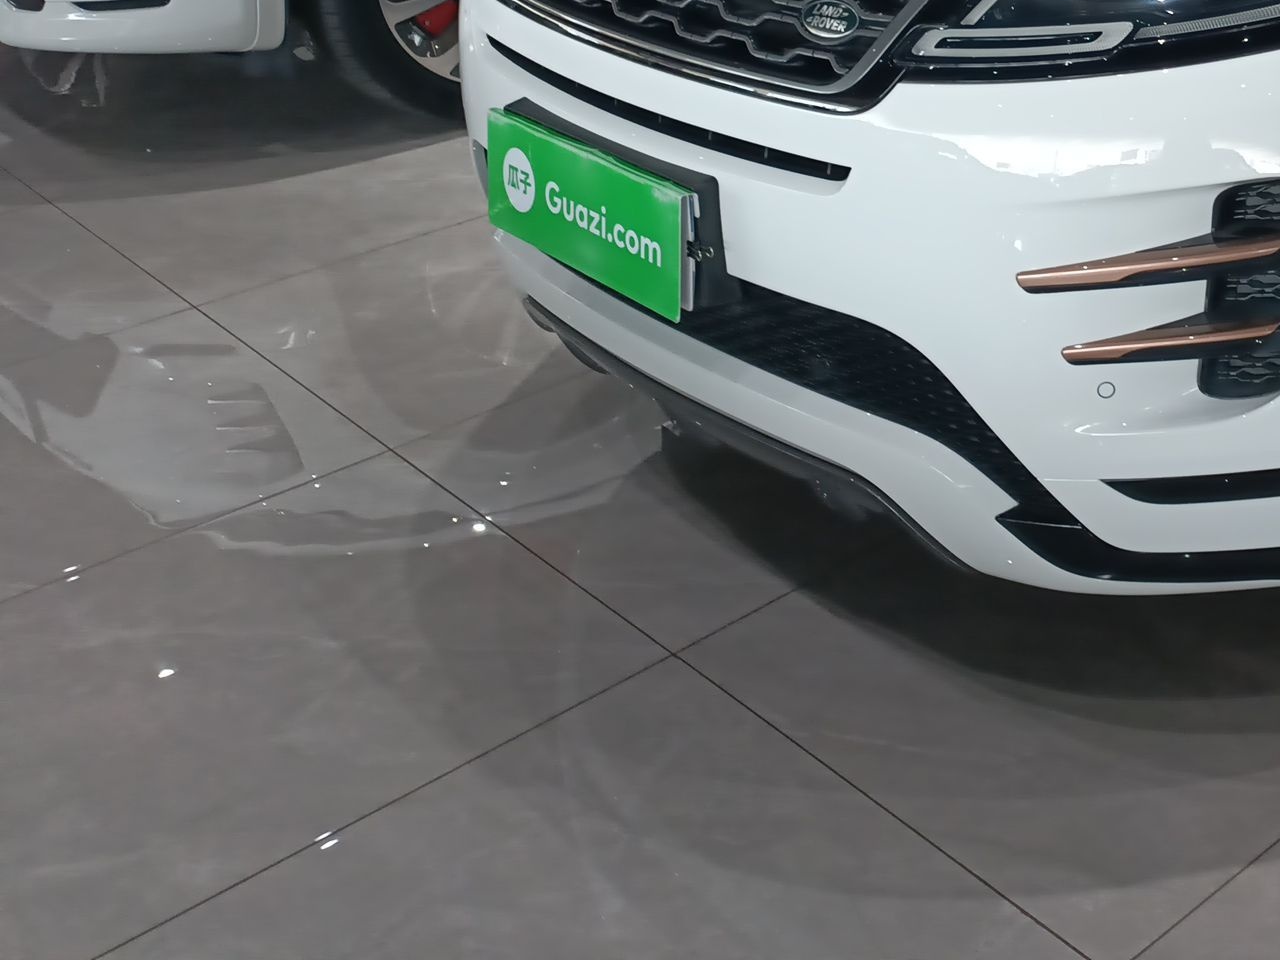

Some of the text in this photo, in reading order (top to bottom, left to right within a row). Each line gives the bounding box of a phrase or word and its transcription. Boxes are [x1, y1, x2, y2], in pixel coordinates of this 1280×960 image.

[812, 3, 843, 18] LAND
[810, 15, 848, 32] ROVER
[508, 164, 532, 195] 瓜子
[545, 180, 662, 267] Guazi.com
